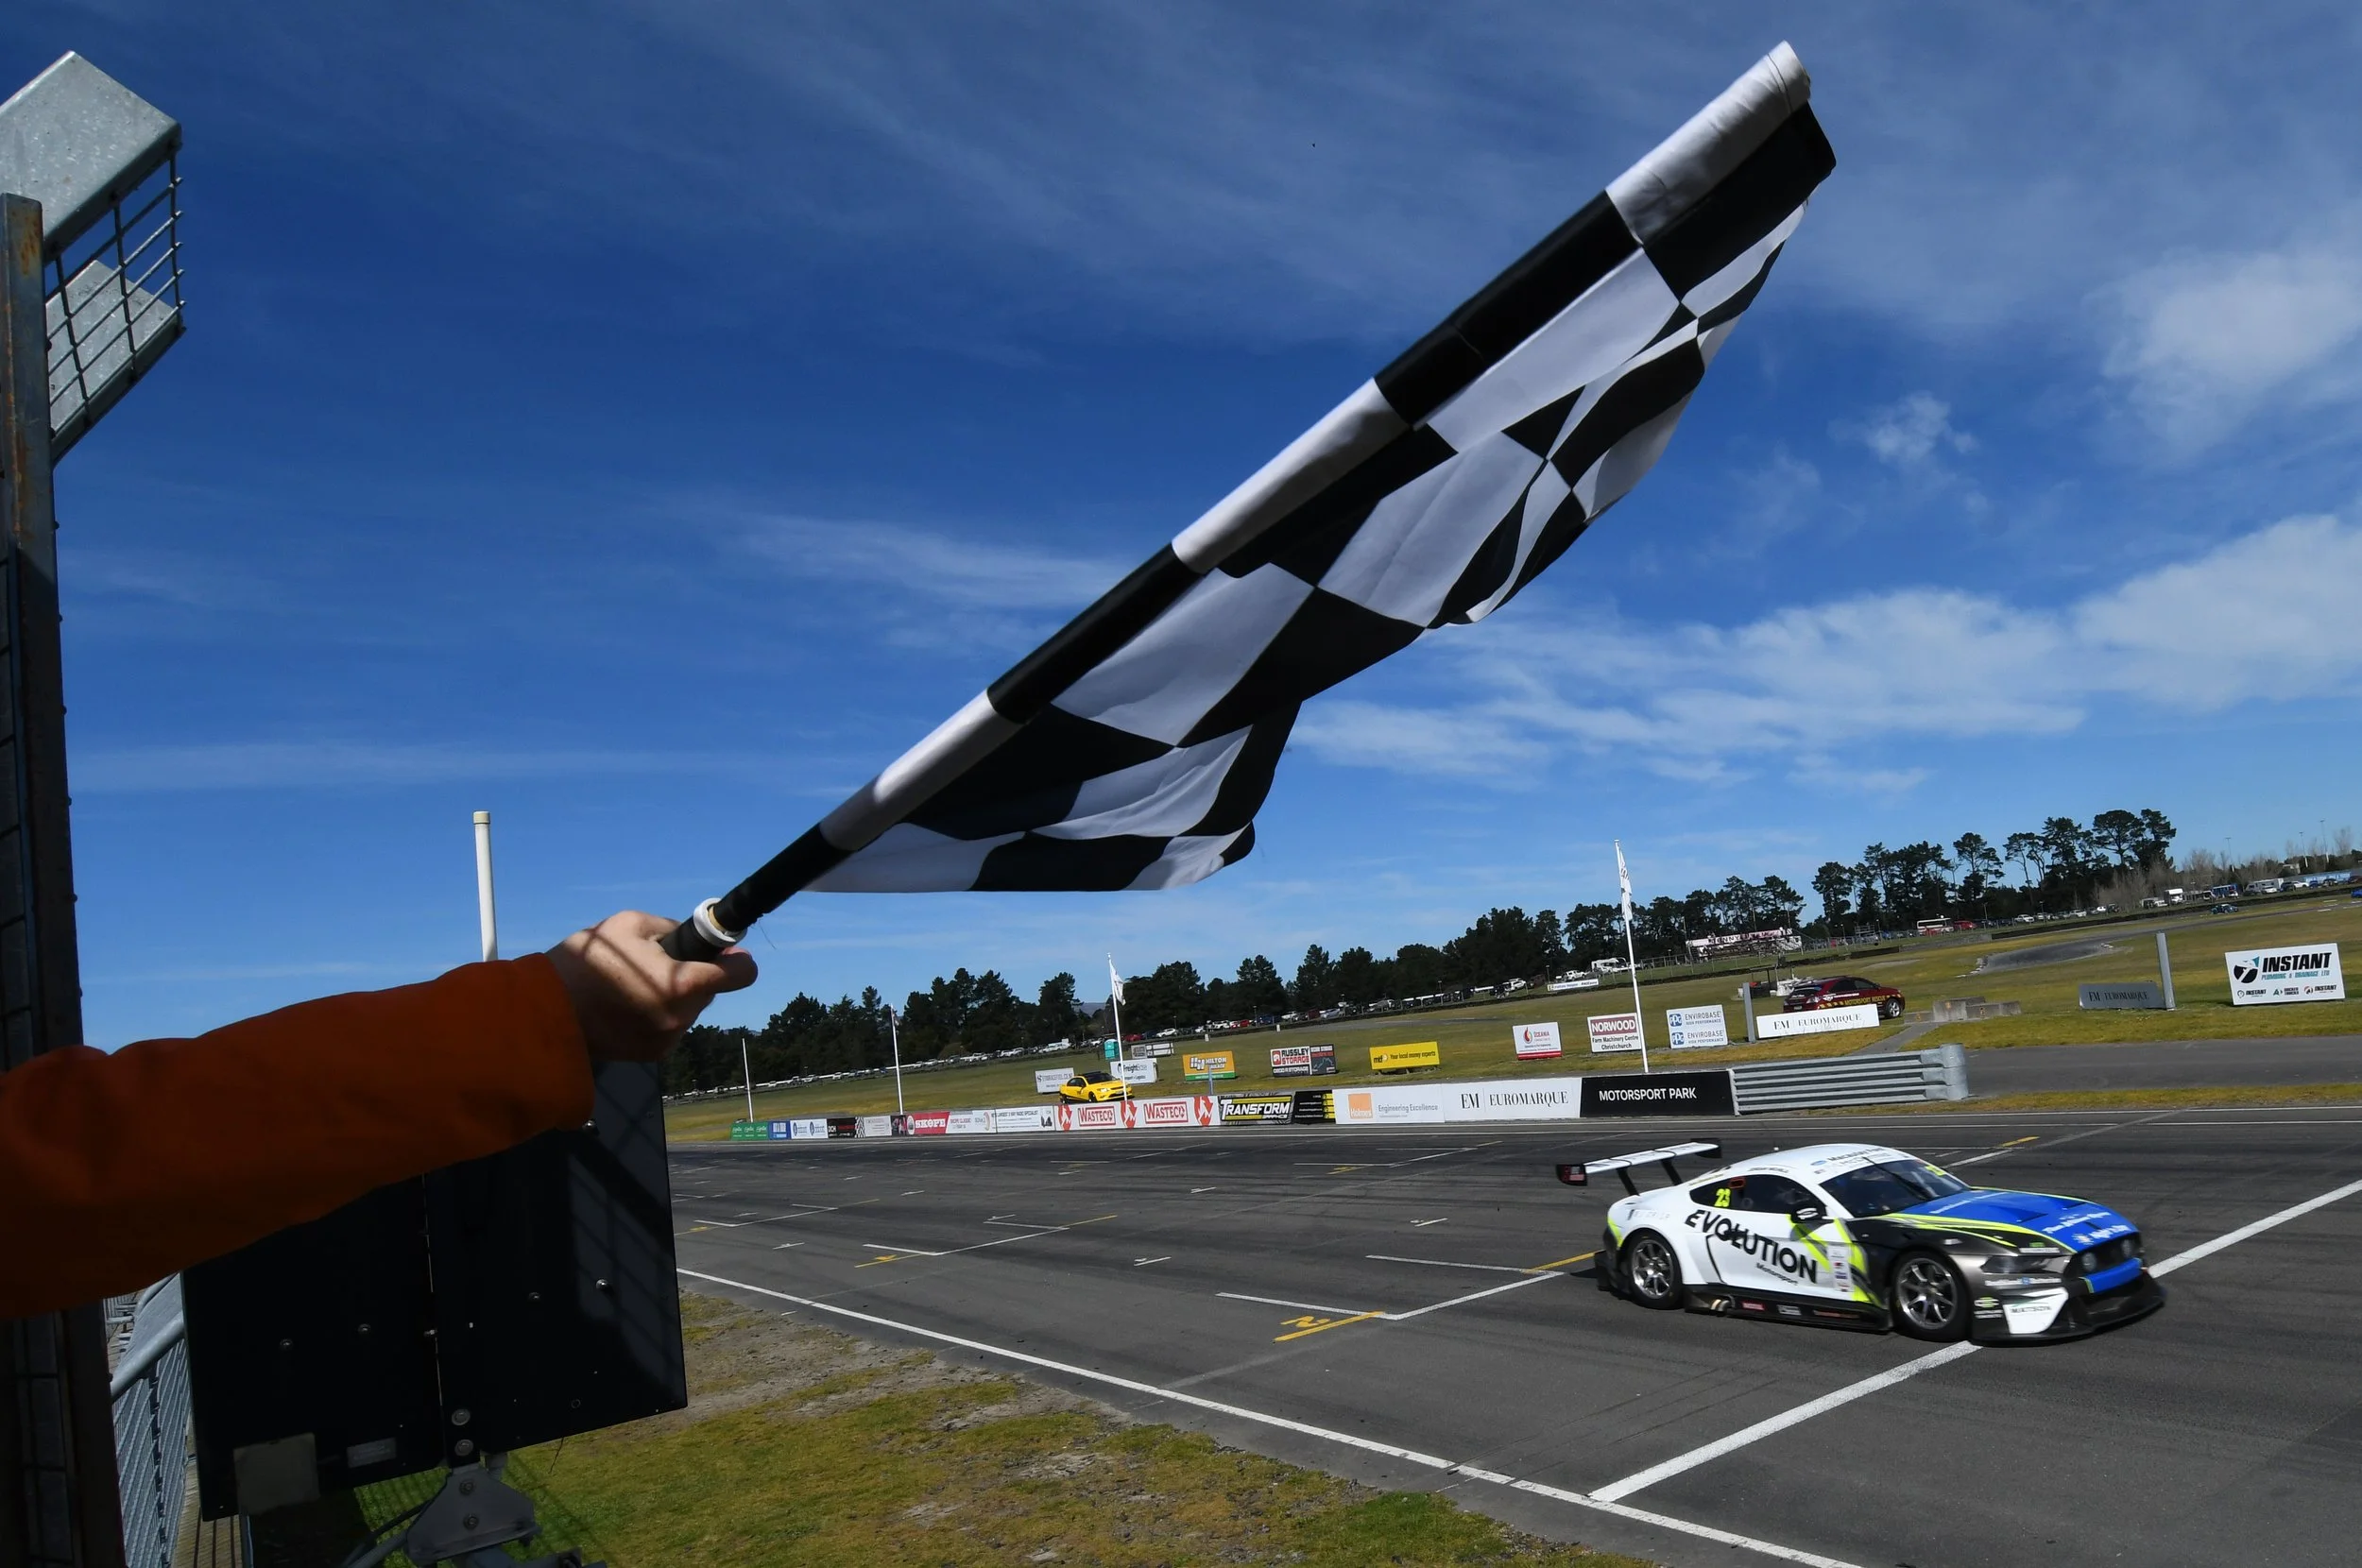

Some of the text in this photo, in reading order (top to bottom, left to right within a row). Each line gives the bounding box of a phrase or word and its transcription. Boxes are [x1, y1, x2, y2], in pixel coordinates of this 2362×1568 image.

[2262, 952, 2332, 973] INSTANT
[1845, 997, 1871, 1005] MOTORSPORT
[2088, 991, 2148, 1002] EM EUROMARQUE
[1685, 1011, 1720, 1020] ENVIROBASE
[1773, 1014, 1861, 1030] EM EUROMARQUE
[1592, 1019, 1635, 1032] NORWOOD
[1687, 1031, 1723, 1039] ENVIROBASE
[1281, 1048, 1309, 1057] RUSSLEY
[1373, 1054, 1382, 1063] mtf
[1282, 1055, 1309, 1065] STORAGE
[1461, 1087, 1697, 1109] EM EUROMARQUE MOTORSPORT PARK
[1078, 1107, 1113, 1122] WASTECO
[1144, 1103, 1185, 1119] WASTECO
[1221, 1099, 1291, 1120] TRANSFORM
[1378, 1104, 1409, 1114] Engineering
[916, 1117, 946, 1129] SKOPE
[1714, 1188, 1731, 1208] 23
[1685, 1209, 1817, 1284] EVOLUTION
[1756, 1262, 1799, 1286] Motorsport
